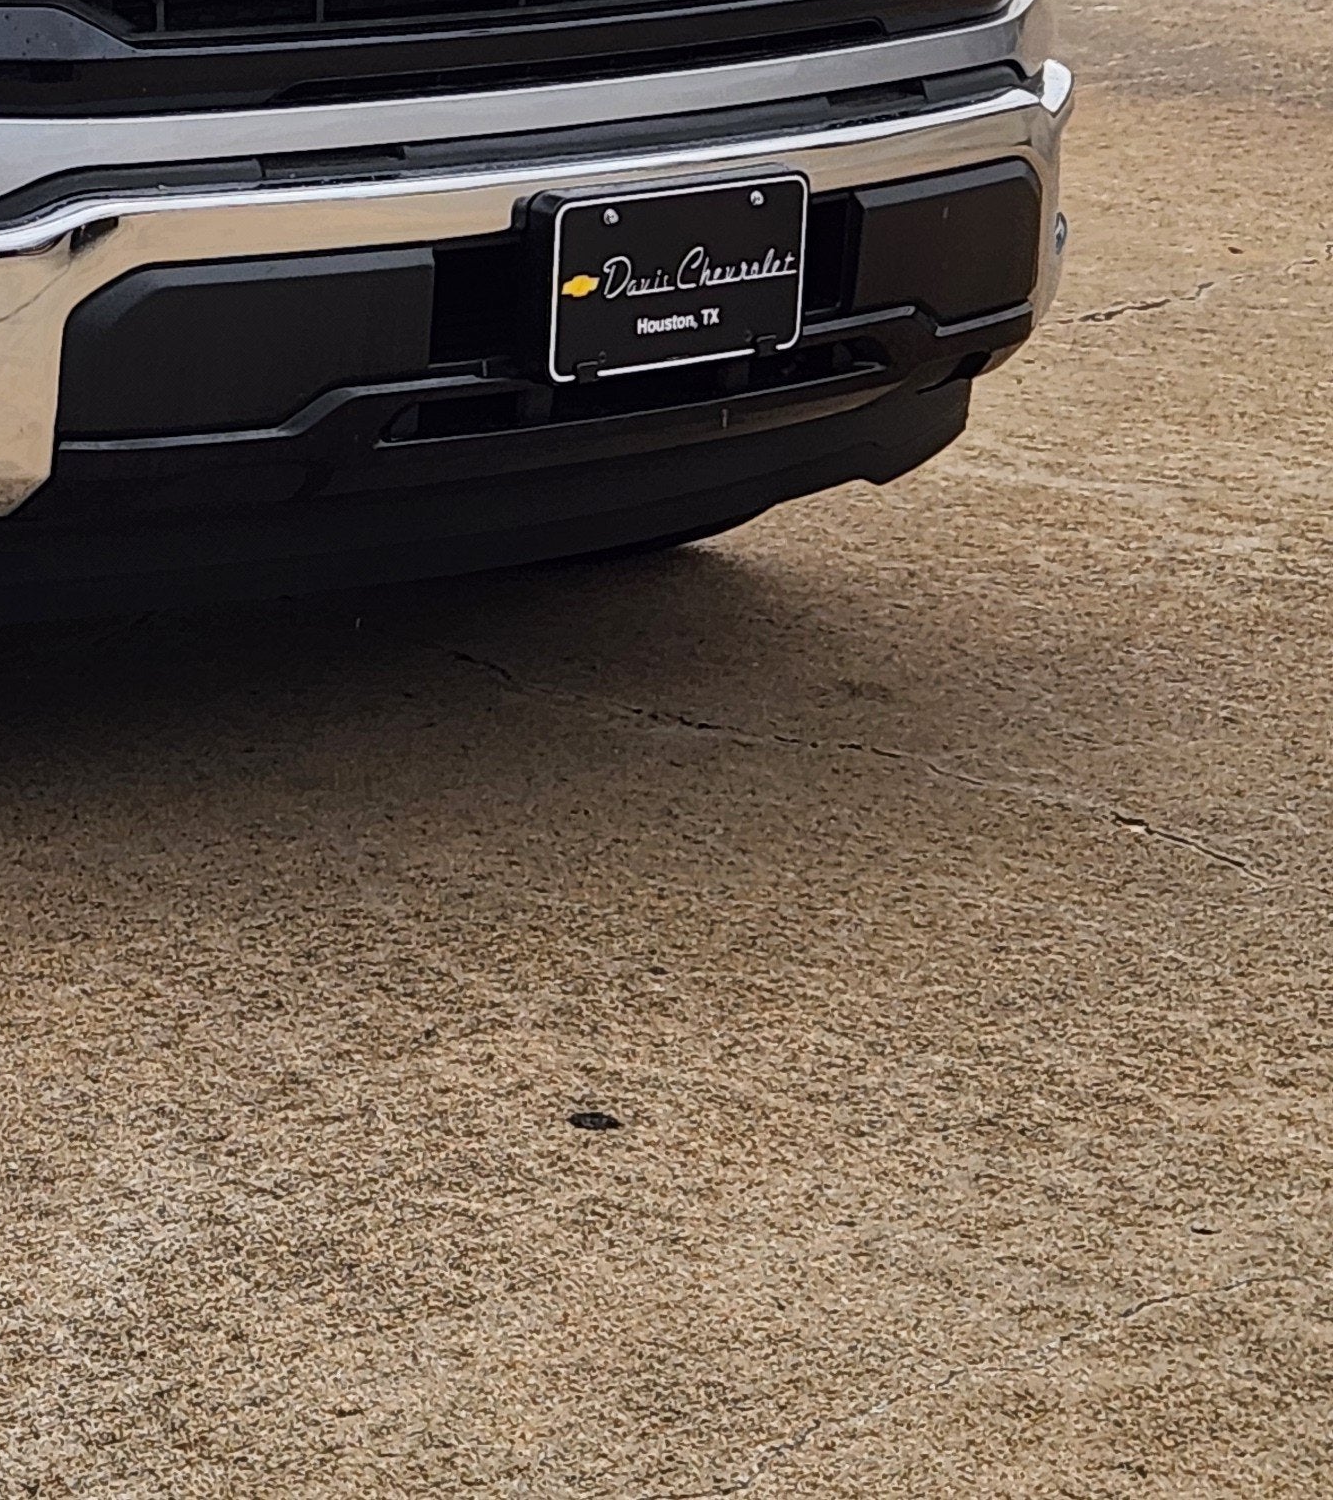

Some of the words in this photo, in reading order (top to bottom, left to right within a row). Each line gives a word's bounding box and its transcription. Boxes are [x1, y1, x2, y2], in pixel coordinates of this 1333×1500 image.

[602, 255, 676, 299] Davis
[676, 246, 798, 290] Chevrolet
[636, 313, 699, 336] Houston,
[700, 307, 721, 326] TX
